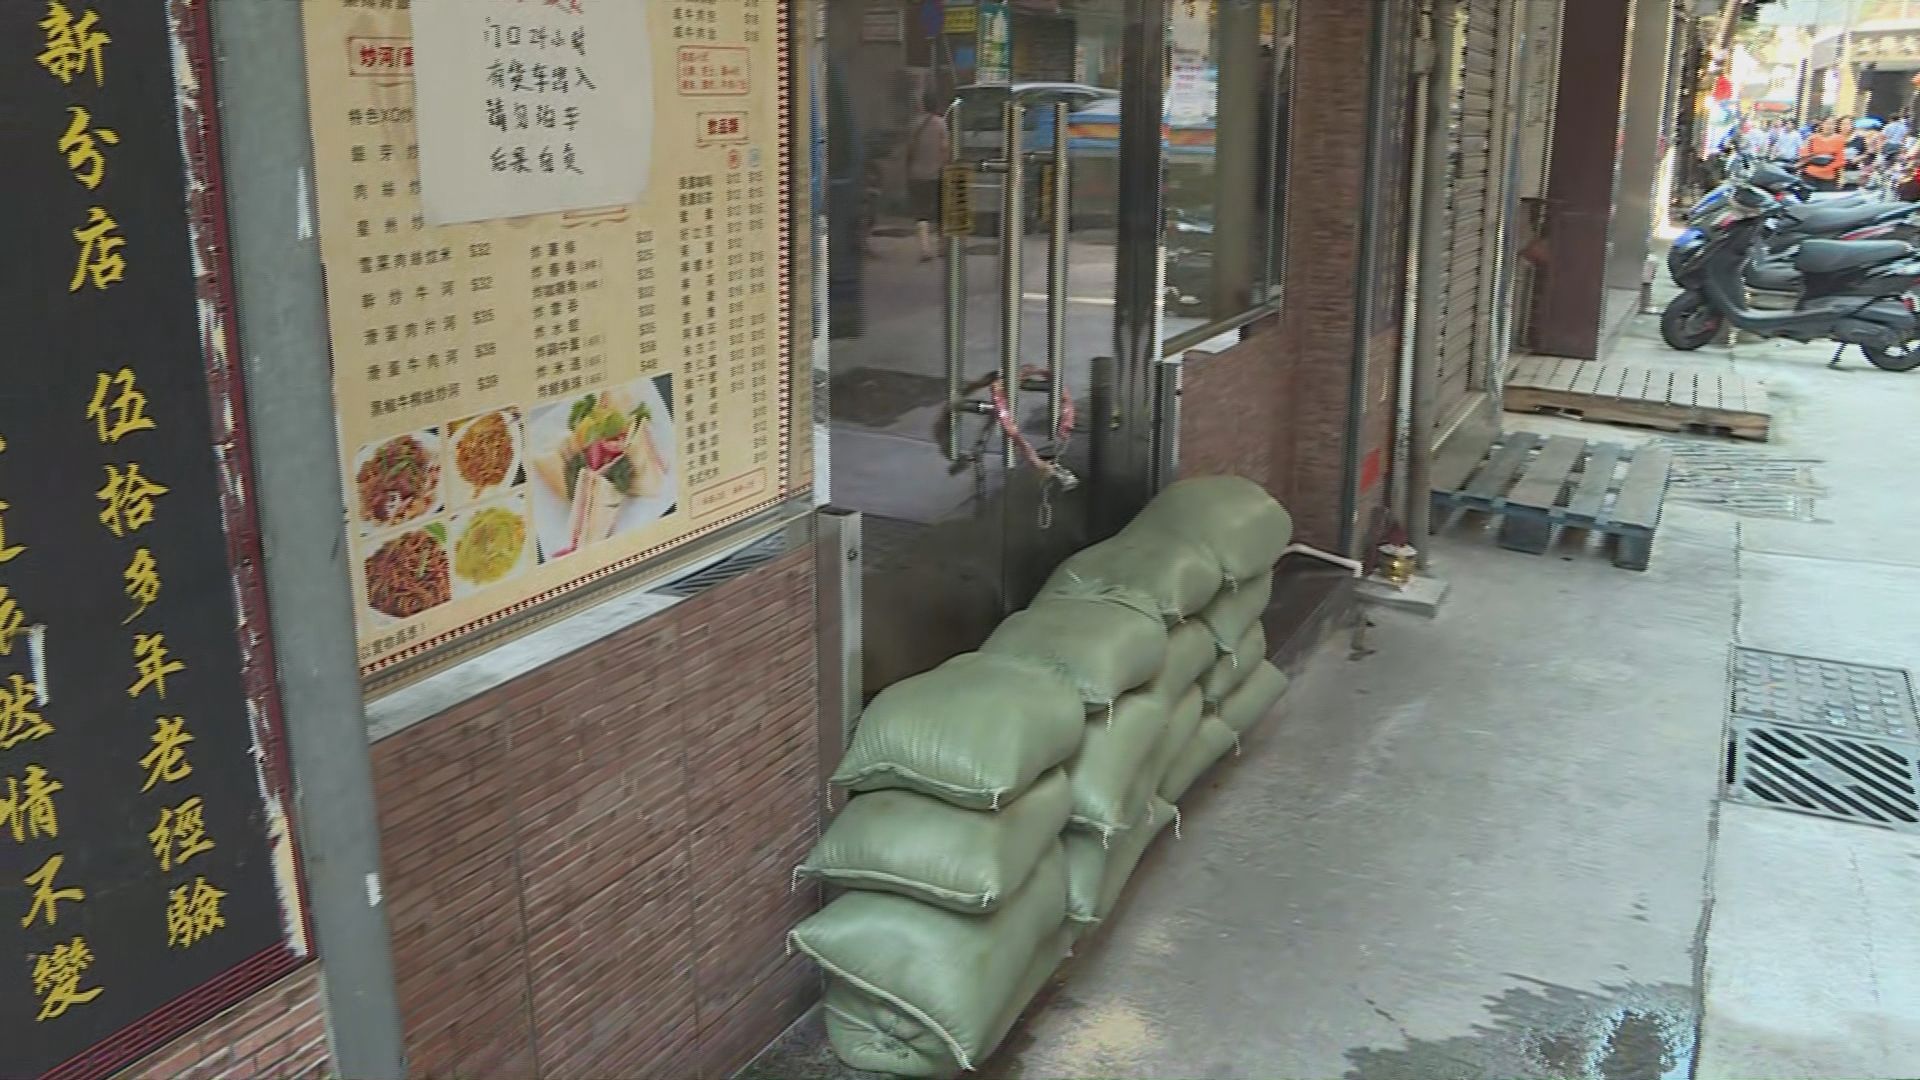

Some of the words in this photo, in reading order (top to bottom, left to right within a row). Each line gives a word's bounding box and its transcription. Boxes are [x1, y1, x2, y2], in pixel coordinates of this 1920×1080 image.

[486, 58, 597, 94] 有货车出入
[486, 96, 581, 132] 请勿泊车
[490, 142, 584, 176] 后果自负
[36, 0, 128, 293] 新分店
[86, 366, 227, 950] 伍拾多年老經驗
